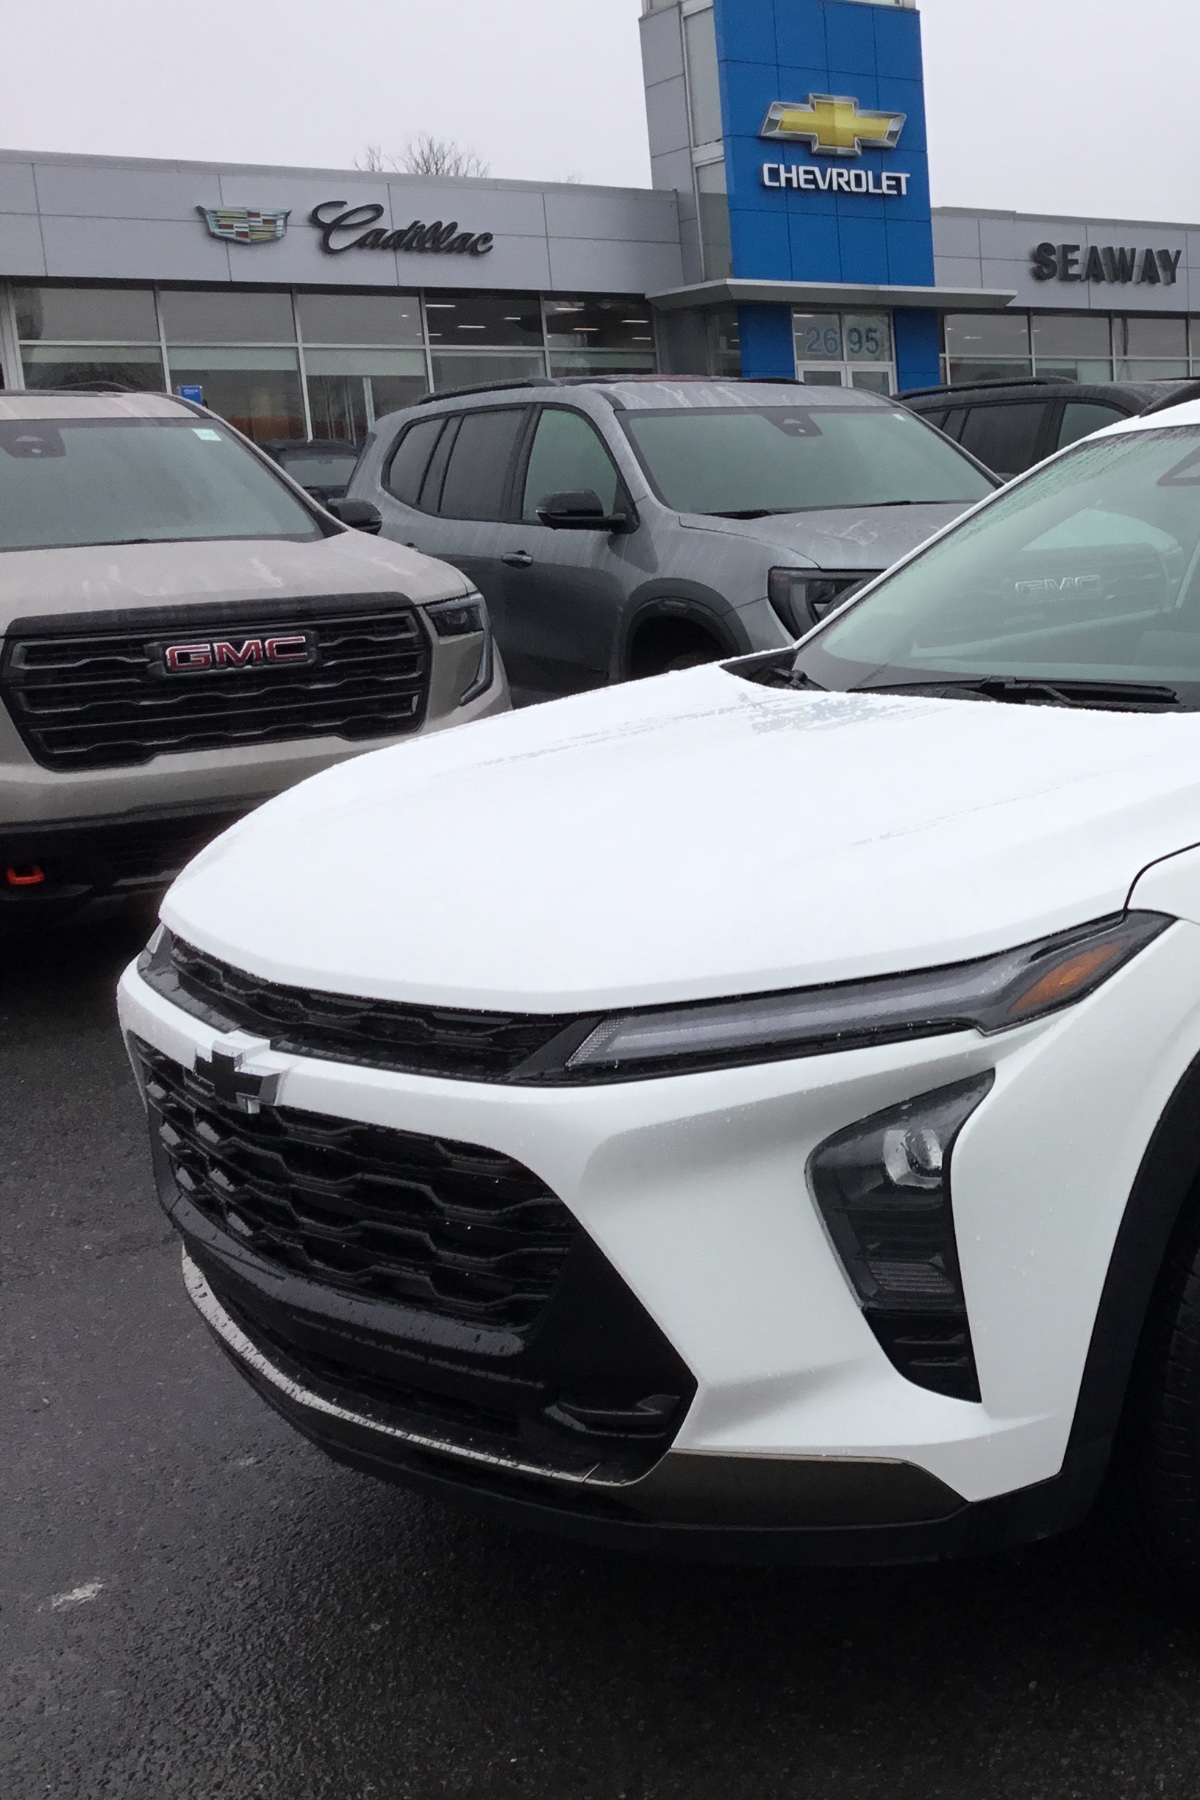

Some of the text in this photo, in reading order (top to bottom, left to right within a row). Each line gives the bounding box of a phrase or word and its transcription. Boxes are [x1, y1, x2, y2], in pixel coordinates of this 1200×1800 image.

[762, 163, 911, 196] CHEVROLET
[310, 200, 493, 255] Cadillac
[1030, 242, 1182, 285] SEAWAY
[165, 636, 307, 670] GMC
